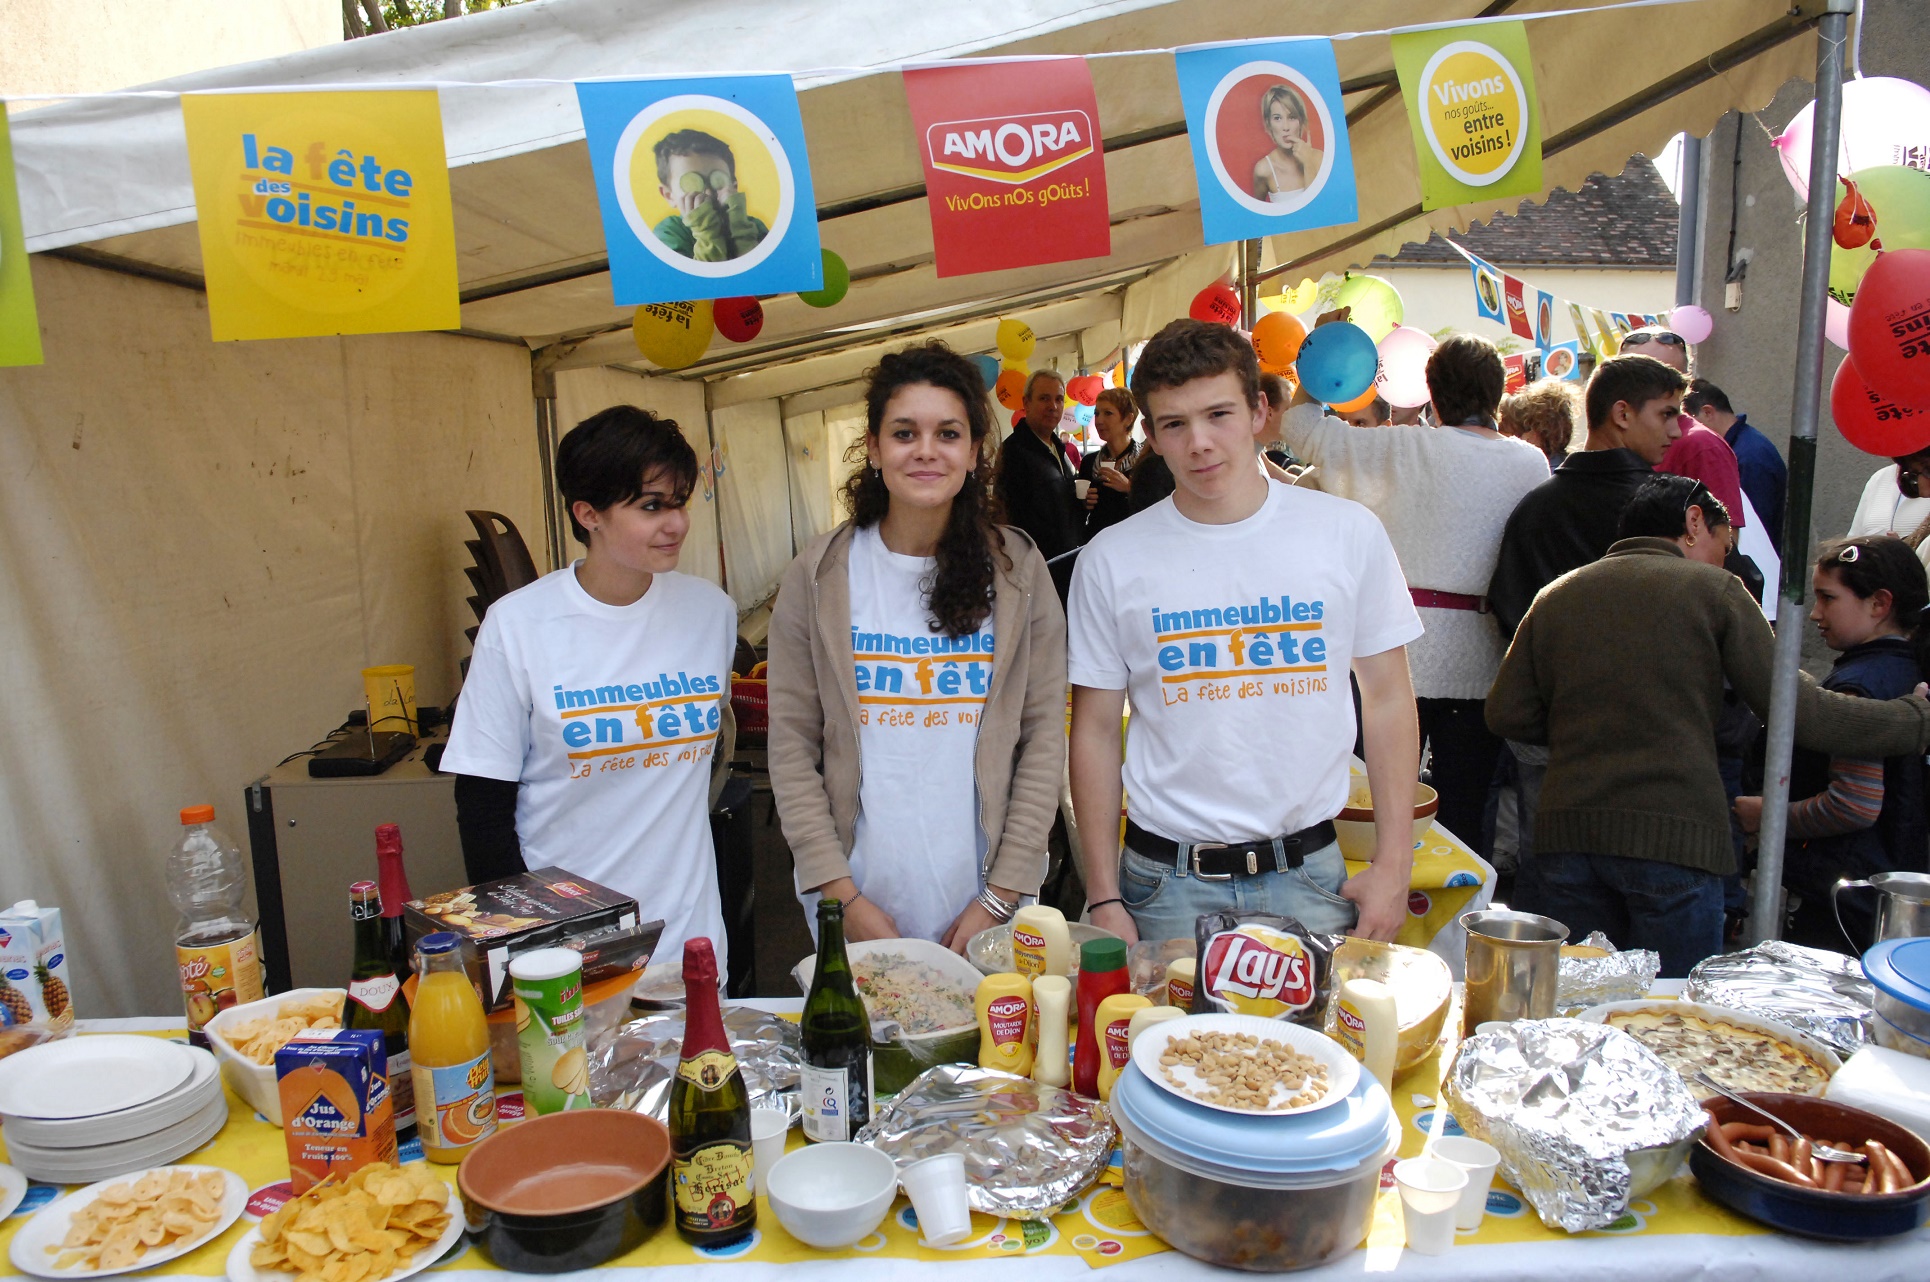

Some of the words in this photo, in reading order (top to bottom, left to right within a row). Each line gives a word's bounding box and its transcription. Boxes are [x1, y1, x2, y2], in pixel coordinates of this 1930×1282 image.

[1433, 75, 1505, 106] Vivons
[1444, 107, 1461, 120] nos
[1463, 112, 1504, 134] entre
[943, 121, 1081, 166] AMORA
[1451, 134, 1504, 160] voisins
[242, 133, 294, 175] la
[304, 141, 413, 197] fête
[255, 178, 291, 193] des
[237, 192, 409, 243] voisins
[645, 304, 673, 322] fête
[675, 313, 690, 329] la
[1152, 596, 1324, 633] immeubles
[851, 625, 994, 655] immeuble
[1158, 642, 1217, 671] en
[1228, 628, 1327, 667] fête
[553, 671, 720, 710] immeubles
[855, 664, 903, 694] en
[1162, 687, 1188, 706] La
[1197, 683, 1231, 701] fête
[1238, 681, 1263, 699] des
[1273, 677, 1327, 697] voisins
[563, 717, 623, 748] en
[635, 702, 719, 740] fête
[877, 708, 915, 727] fête
[923, 710, 949, 727] des
[570, 762, 592, 779] La
[600, 756, 635, 772] fête
[643, 751, 669, 768] des
[1015, 931, 1044, 946] AMORA
[1212, 937, 1305, 999] Lay's
[360, 981, 394, 997] DOUX
[990, 1001, 1026, 1015] AMORA
[370, 1080, 382, 1093] Jus
[310, 1102, 335, 1115] Jus
[291, 1116, 356, 1131] d'Orange
[301, 1152, 329, 1160] Fruits
[304, 1143, 335, 1152] Teneur
